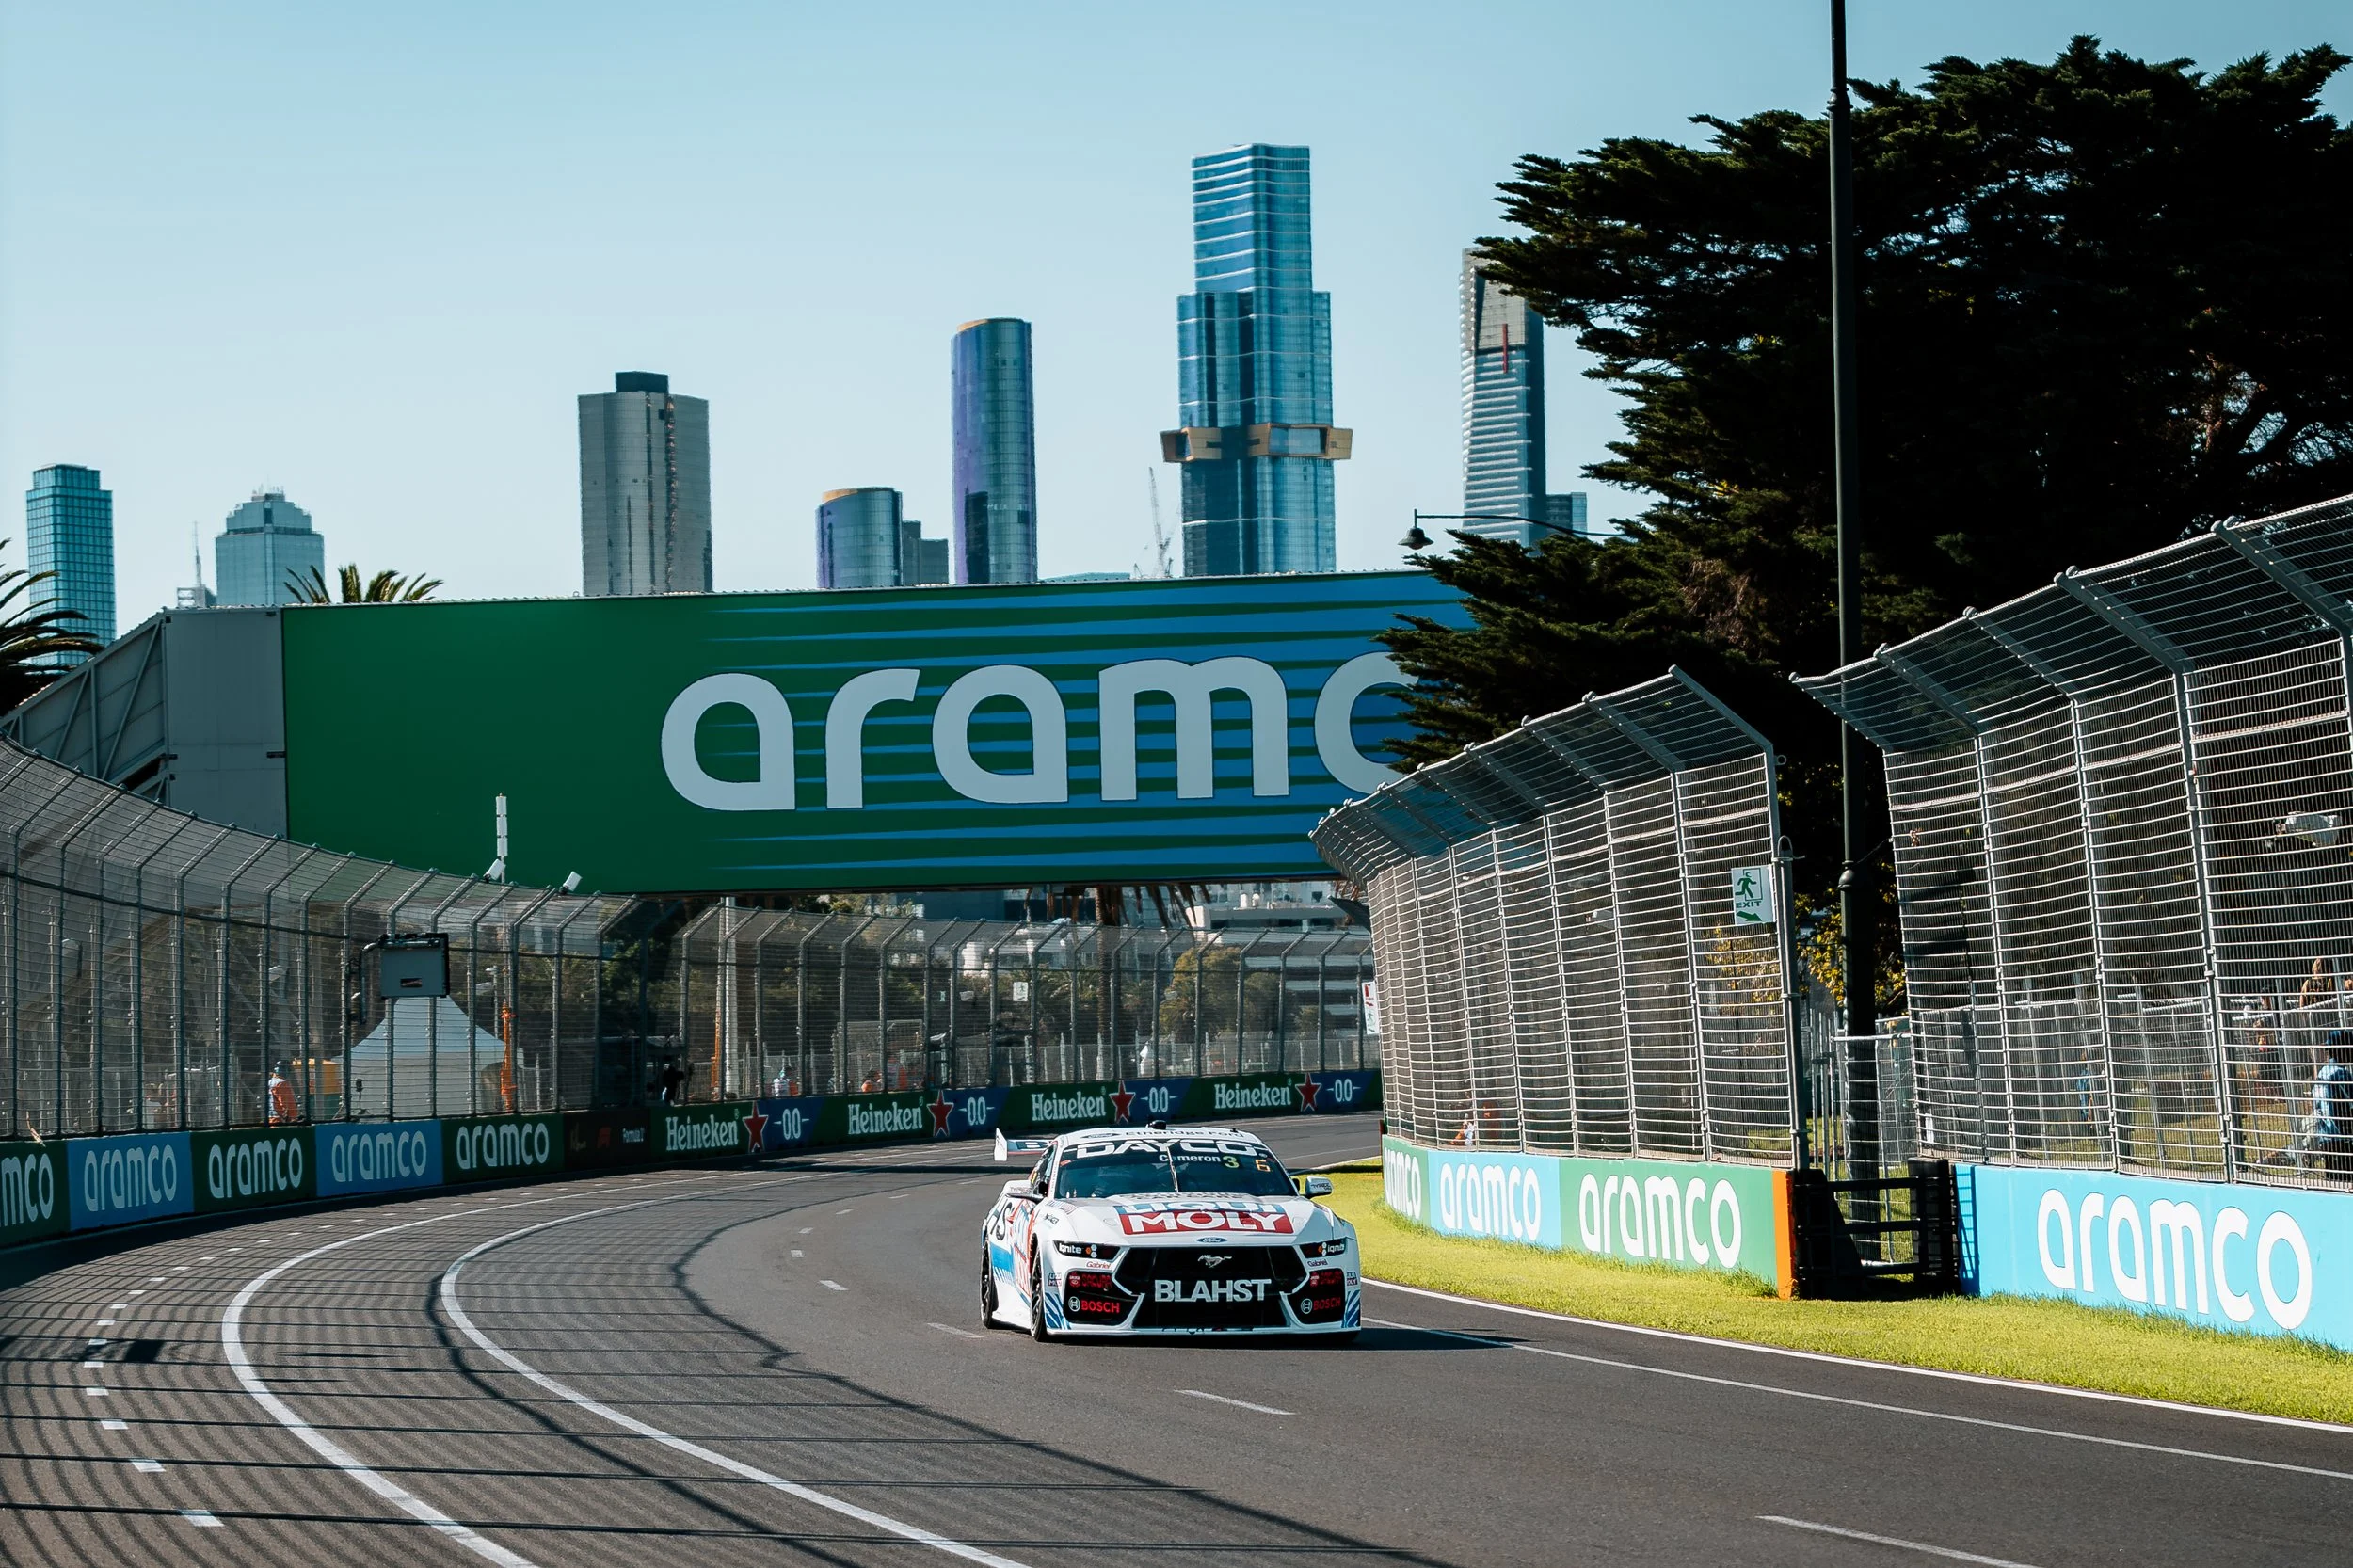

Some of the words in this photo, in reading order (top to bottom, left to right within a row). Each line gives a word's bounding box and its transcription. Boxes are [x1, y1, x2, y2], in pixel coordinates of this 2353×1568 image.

[661, 651, 1421, 812] aramc
[1736, 901, 1762, 909] EXIT
[1031, 1091, 1107, 1121] Heineken
[1213, 1082, 1291, 1109] Heineken
[665, 1113, 739, 1151] Heineken
[848, 1101, 923, 1135] Heineken
[332, 1130, 427, 1182] aramco
[456, 1123, 550, 1170] aramco
[1076, 1139, 1257, 1159] DAYCO
[1223, 1156, 1240, 1168] 3
[84, 1144, 177, 1212] aramco
[208, 1138, 302, 1199] aramco
[1385, 1147, 1421, 1220] aramco
[0, 1153, 54, 1226] mco
[1440, 1162, 1541, 1240] aramco
[1128, 1211, 1284, 1232] MOLY
[1579, 1173, 1742, 1269] aramco
[1086, 1261, 1111, 1270] Gabriel
[2037, 1189, 2313, 1330] aramco
[1081, 1300, 1120, 1314] BOSCH
[1155, 1279, 1272, 1302] BLAHST
[1313, 1297, 1341, 1311] BOSCH
